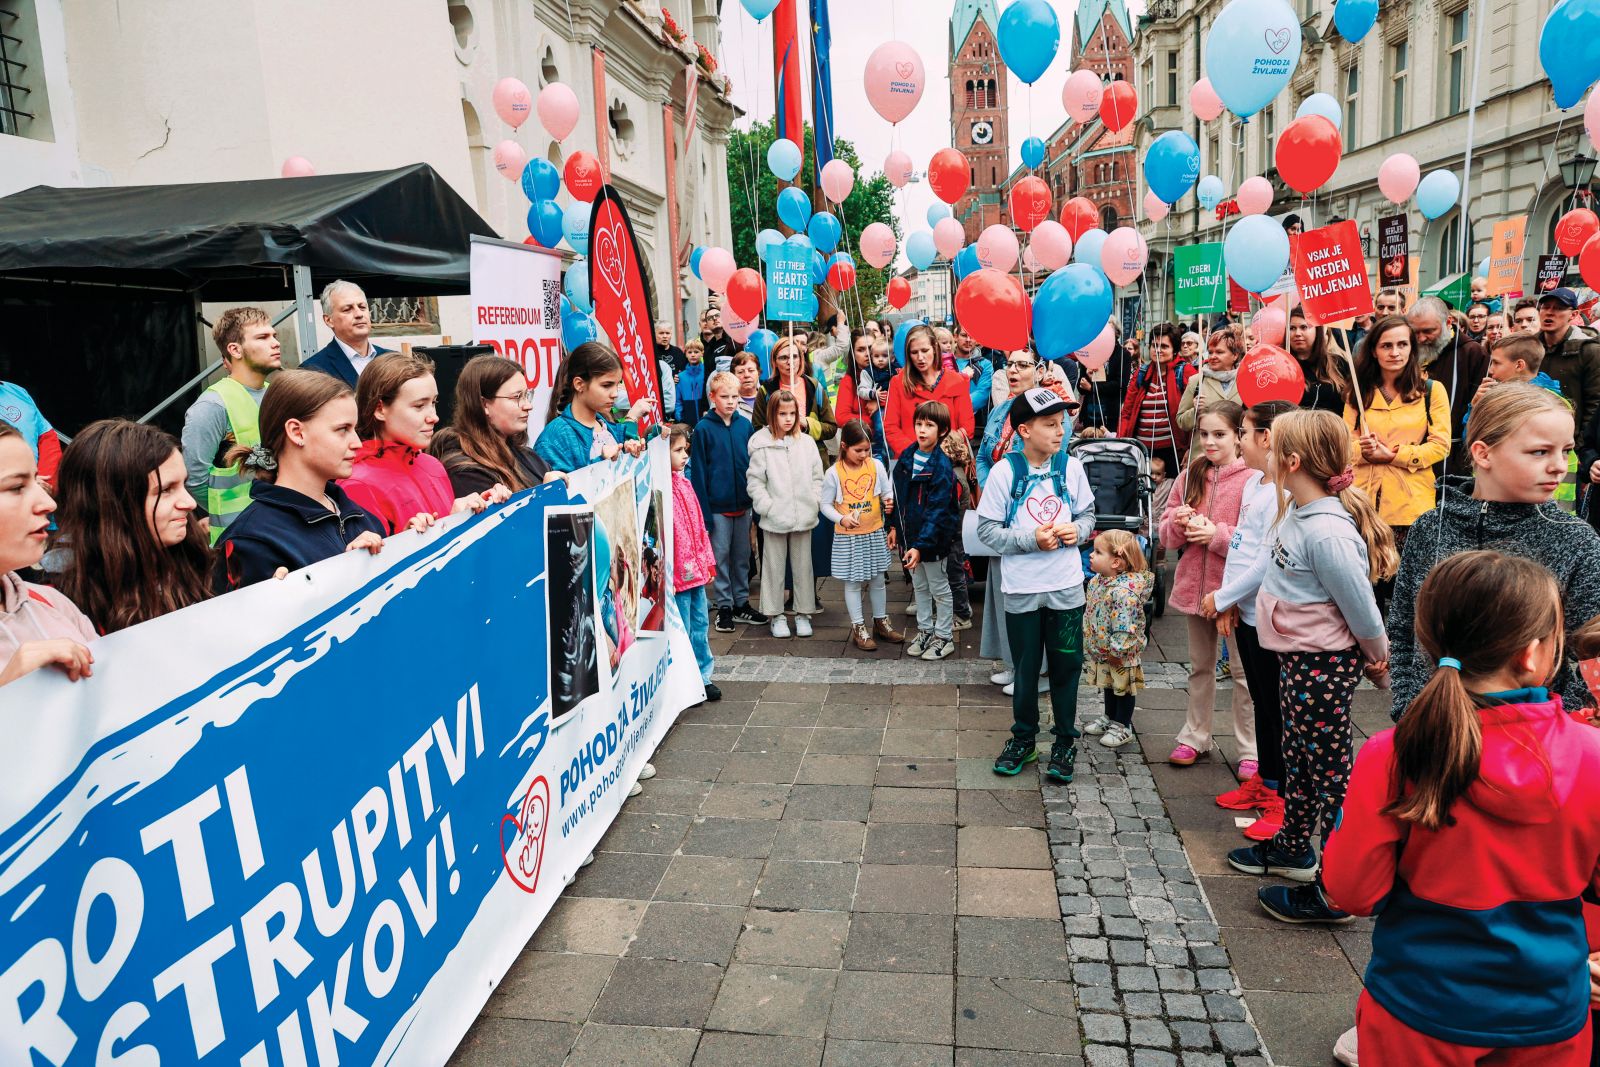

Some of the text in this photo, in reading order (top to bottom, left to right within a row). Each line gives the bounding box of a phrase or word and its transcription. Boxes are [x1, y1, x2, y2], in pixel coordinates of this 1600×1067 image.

[1254, 58, 1282, 66] POHOD
[1252, 66, 1288, 75] ŽIVLJENJE
[1307, 244, 1343, 263] VSAK JE
[1381, 242, 1407, 259] ČLOVEK!
[775, 260, 805, 271] LET THEIR
[1189, 264, 1211, 275] IZBERI
[1307, 258, 1350, 281] VREDEN
[773, 272, 808, 286] HEARTS
[1178, 275, 1223, 289] ŽIVLJENJE!
[1302, 272, 1363, 300] ŽIVLJENJA!
[778, 287, 803, 301] BEAT!
[477, 306, 541, 325] REFERENDUM
[1032, 389, 1056, 406] WILD
[560, 722, 617, 808] POHOD
[618, 701, 629, 742] ZA
